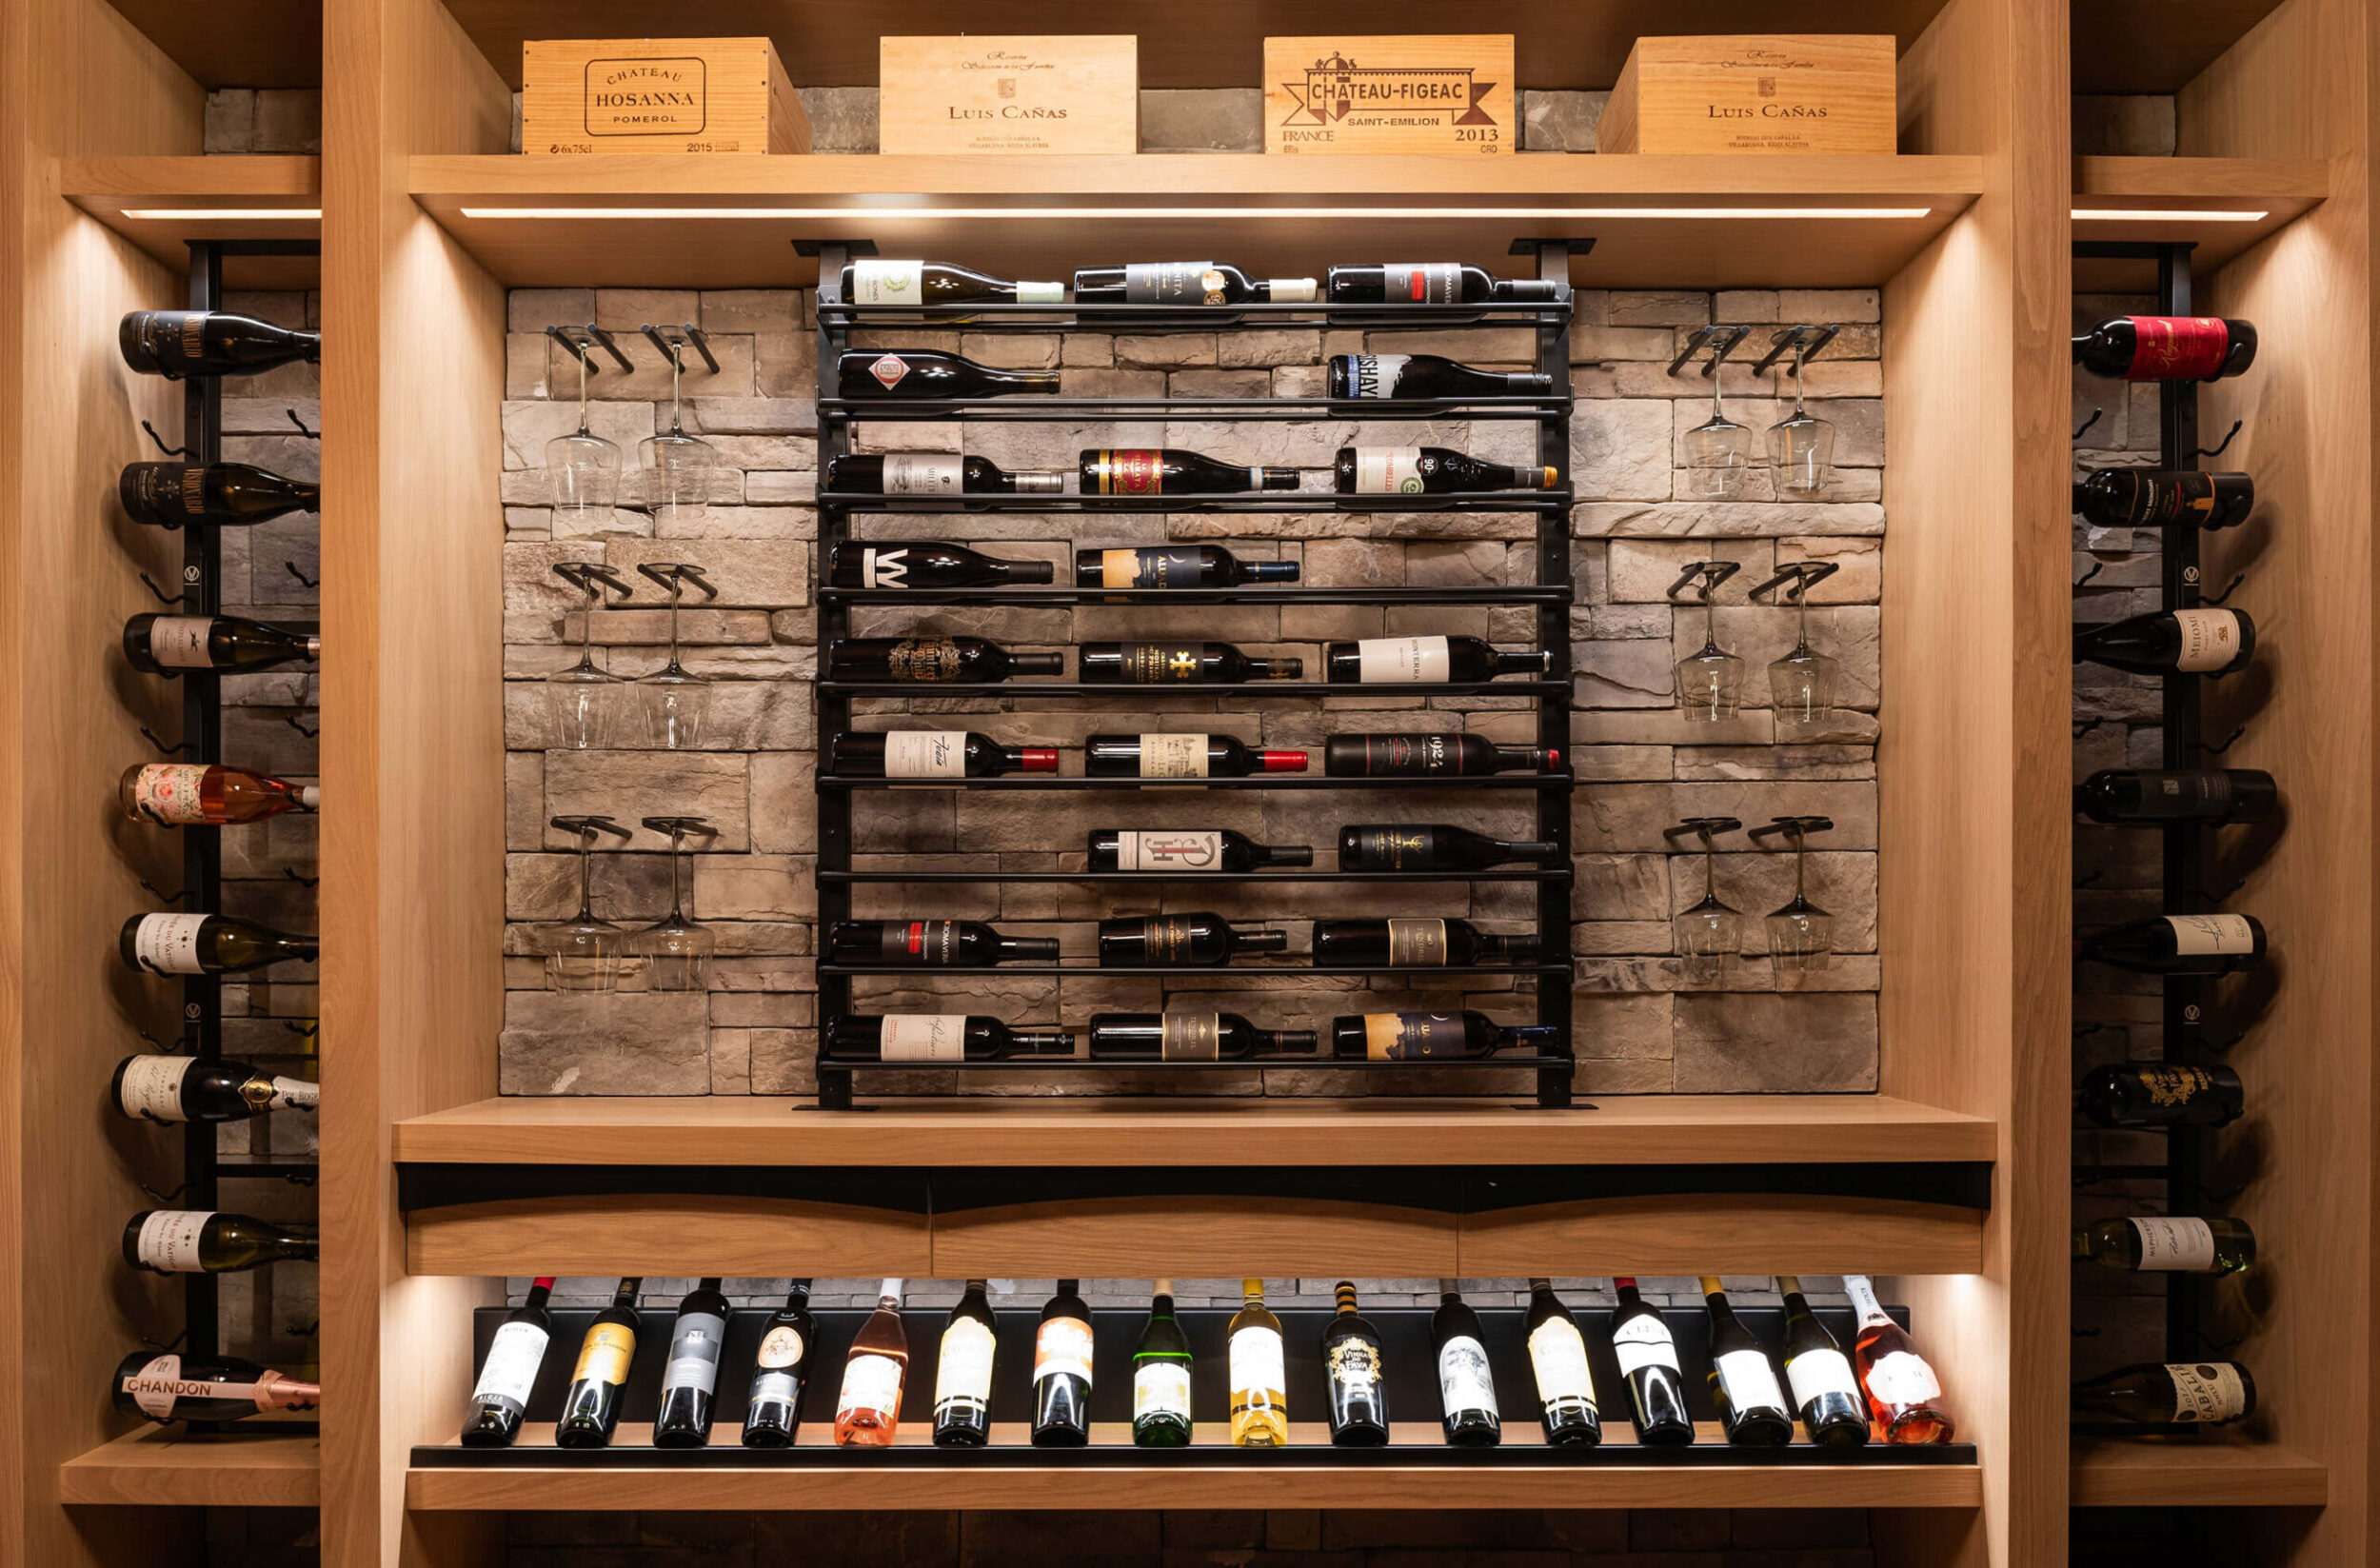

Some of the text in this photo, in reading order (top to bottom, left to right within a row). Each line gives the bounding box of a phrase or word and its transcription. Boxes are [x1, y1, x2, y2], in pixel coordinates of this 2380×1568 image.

[596, 91, 695, 109] HOSANNA
[948, 105, 1068, 120] LUIS CAÑAS
[1708, 104, 1828, 118] LUIS CAÑAS
[612, 114, 678, 124] POMEROL
[1347, 117, 1440, 127] SAINT-EMILION
[1282, 130, 1335, 142] FRANCE
[1455, 129, 1499, 142] 2013
[686, 143, 713, 152] 2015
[2157, 320, 2178, 369] Raymond
[182, 468, 206, 514] VISIONARIO
[876, 548, 908, 588] W
[2190, 617, 2201, 659] MEIOMI
[1429, 736, 1443, 768] 1924
[128, 1379, 212, 1397] CHANDON
[479, 1395, 504, 1403] RIOJA
